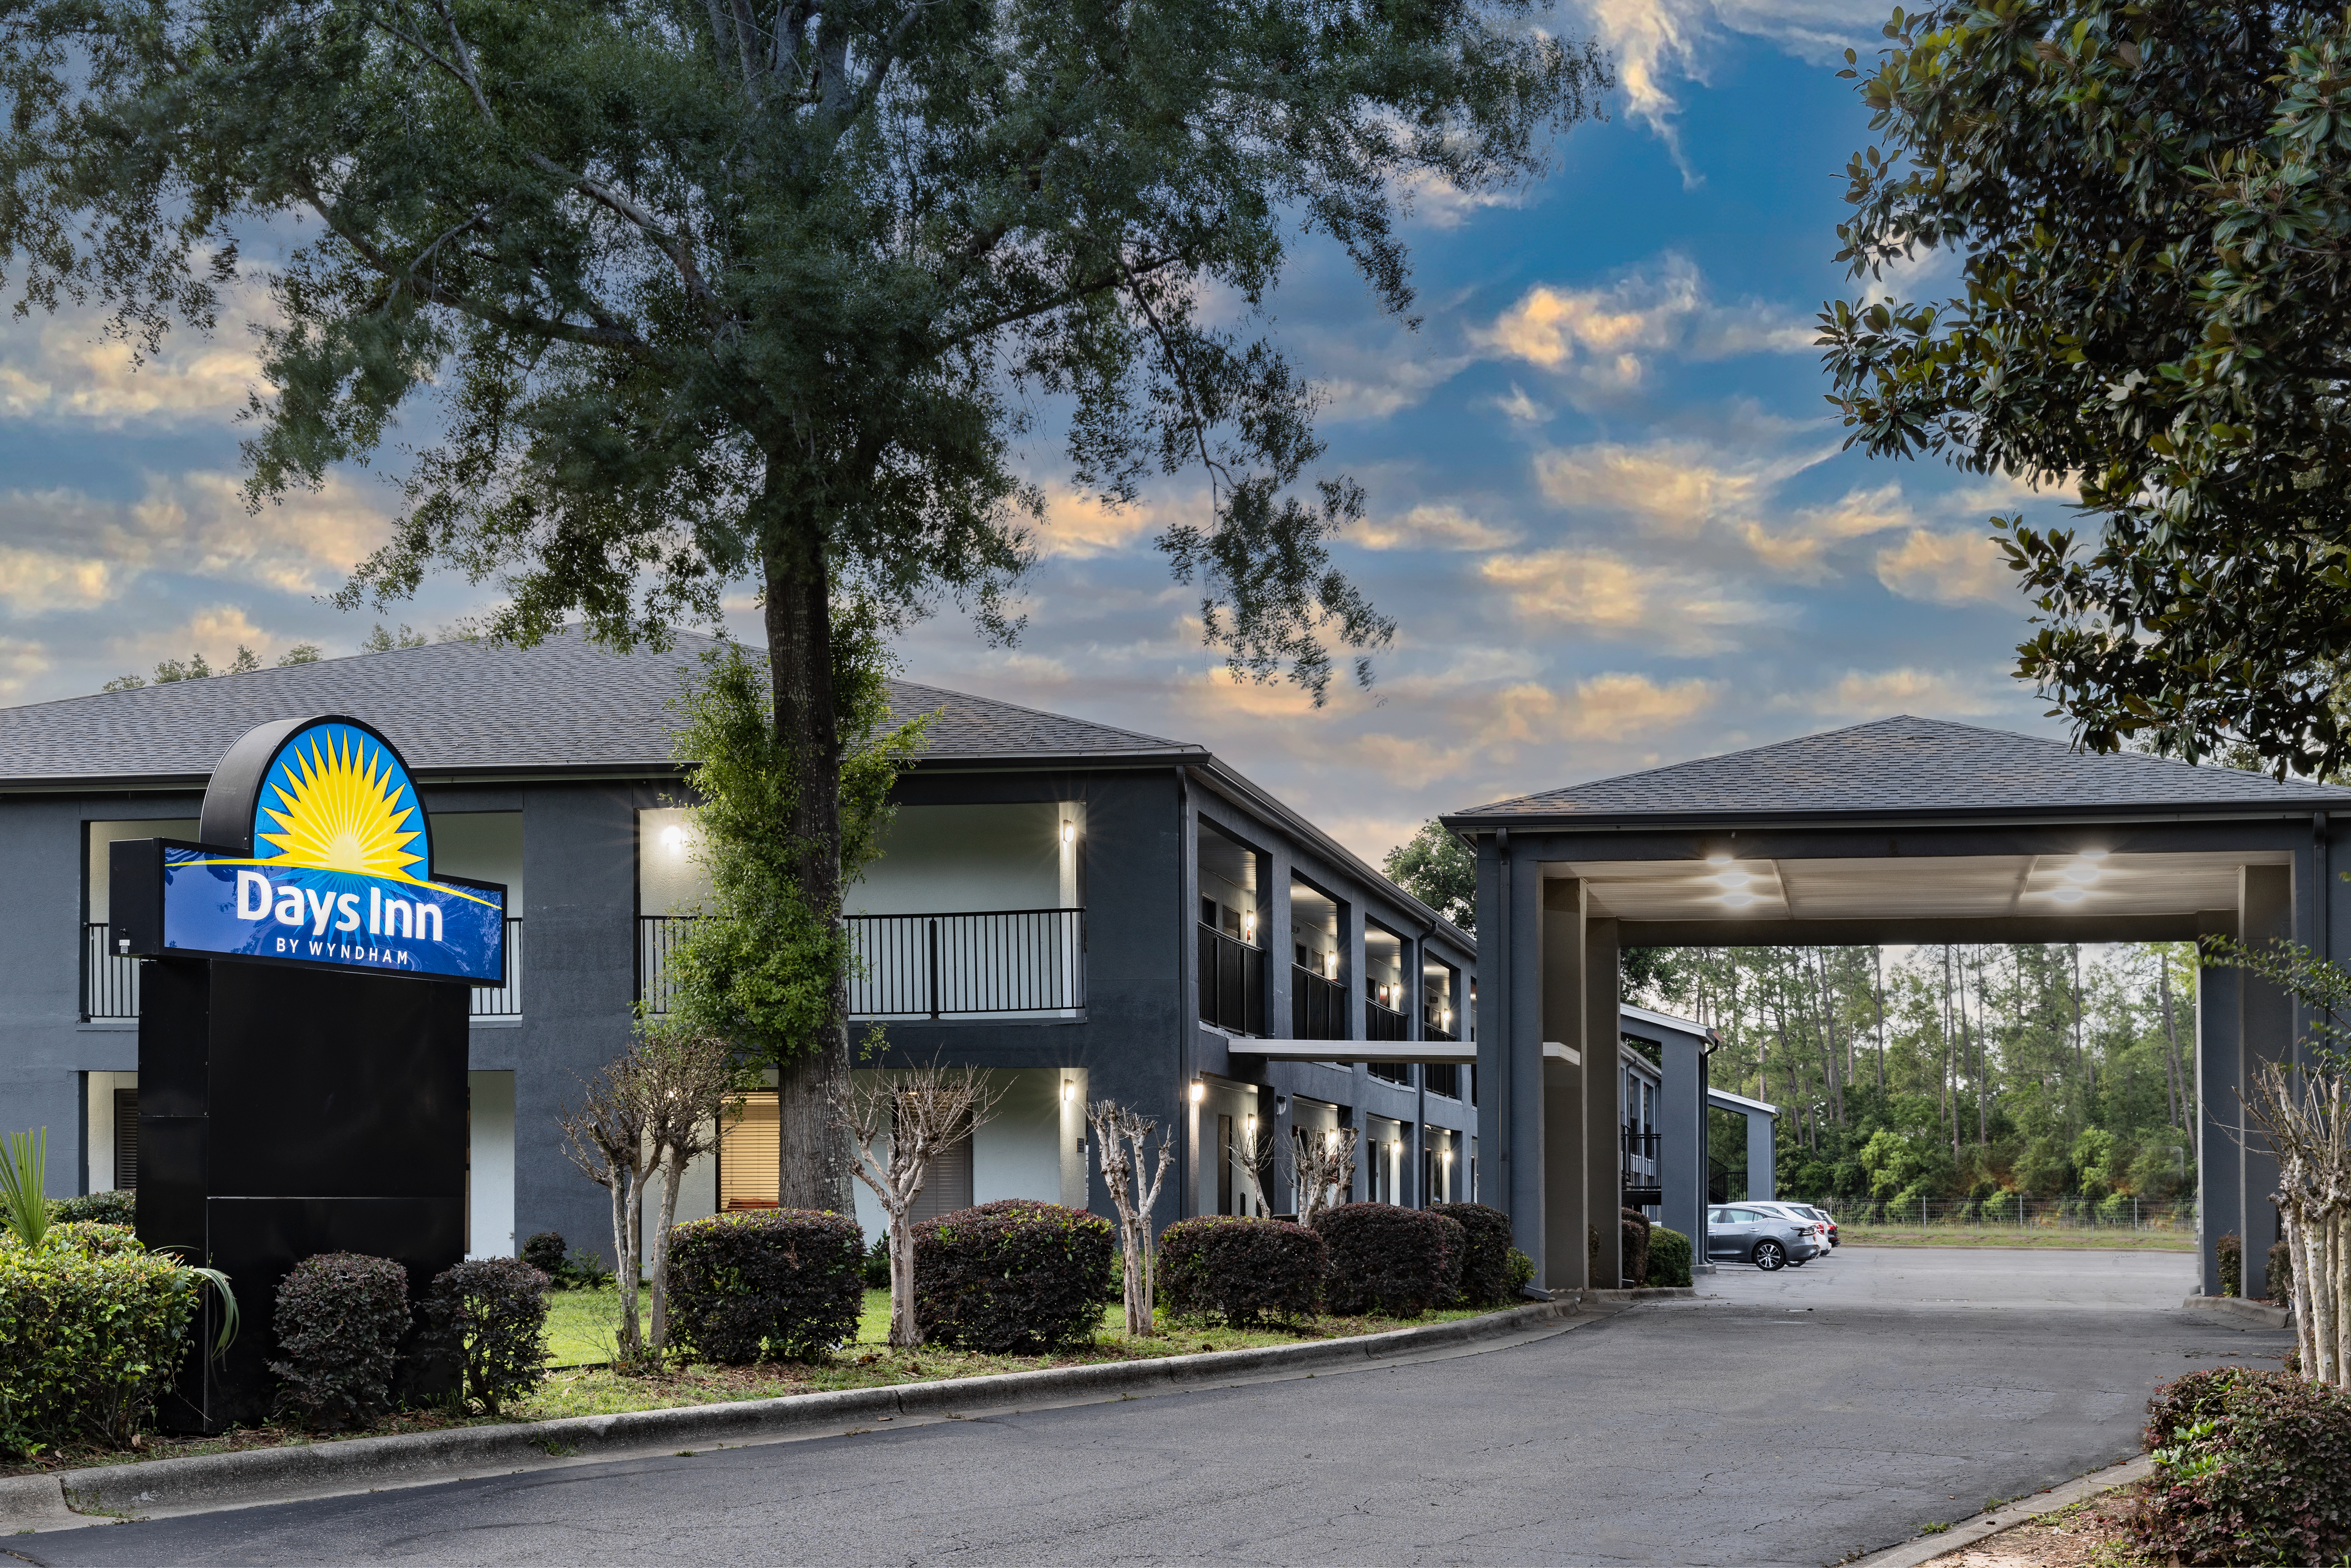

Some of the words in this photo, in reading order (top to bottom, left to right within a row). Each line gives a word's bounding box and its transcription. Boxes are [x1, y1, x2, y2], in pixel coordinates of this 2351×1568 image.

[237, 870, 360, 936] Days
[369, 887, 442, 942] Inn
[276, 938, 299, 953] BY
[309, 941, 408, 965] WYNDHAM
